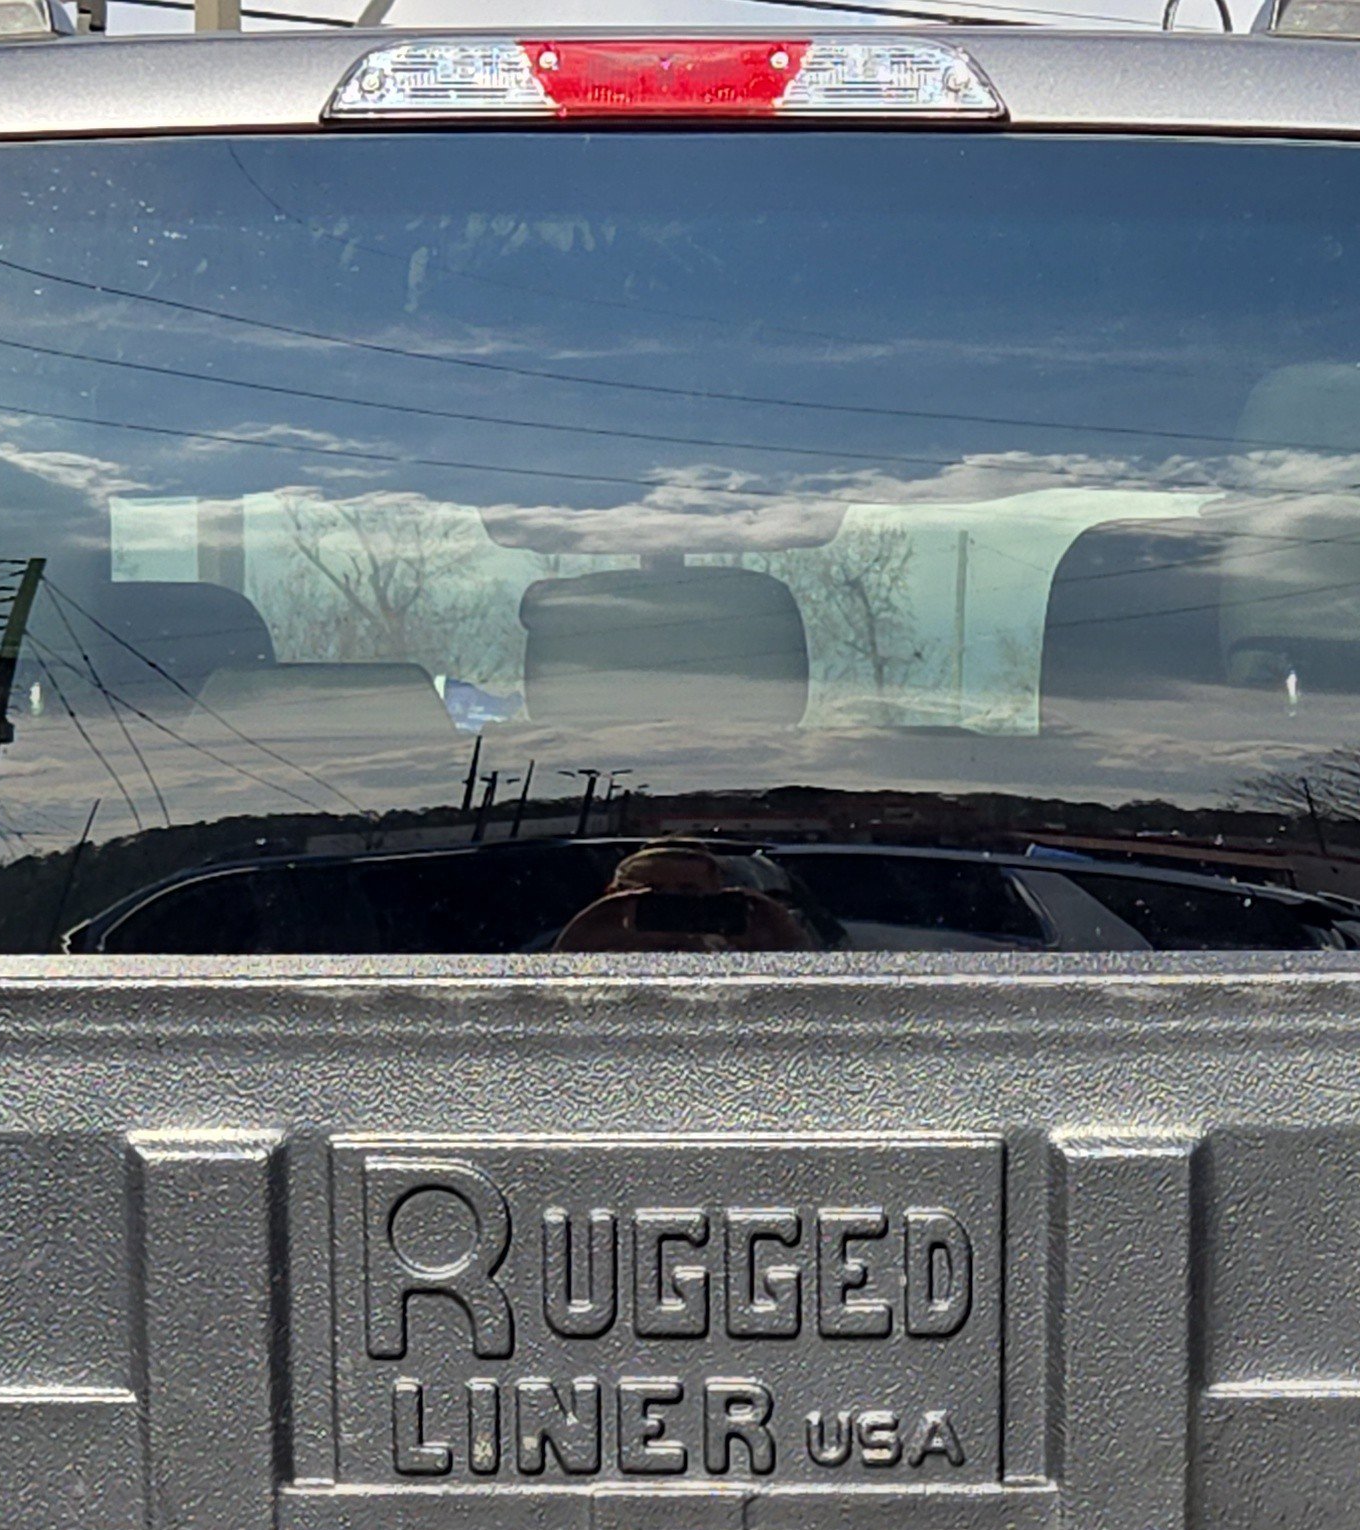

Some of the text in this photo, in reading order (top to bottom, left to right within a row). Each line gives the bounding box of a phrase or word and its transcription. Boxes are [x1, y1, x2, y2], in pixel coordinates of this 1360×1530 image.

[364, 1156, 974, 1360] RUGGED
[391, 1375, 965, 1477] LINER USA
